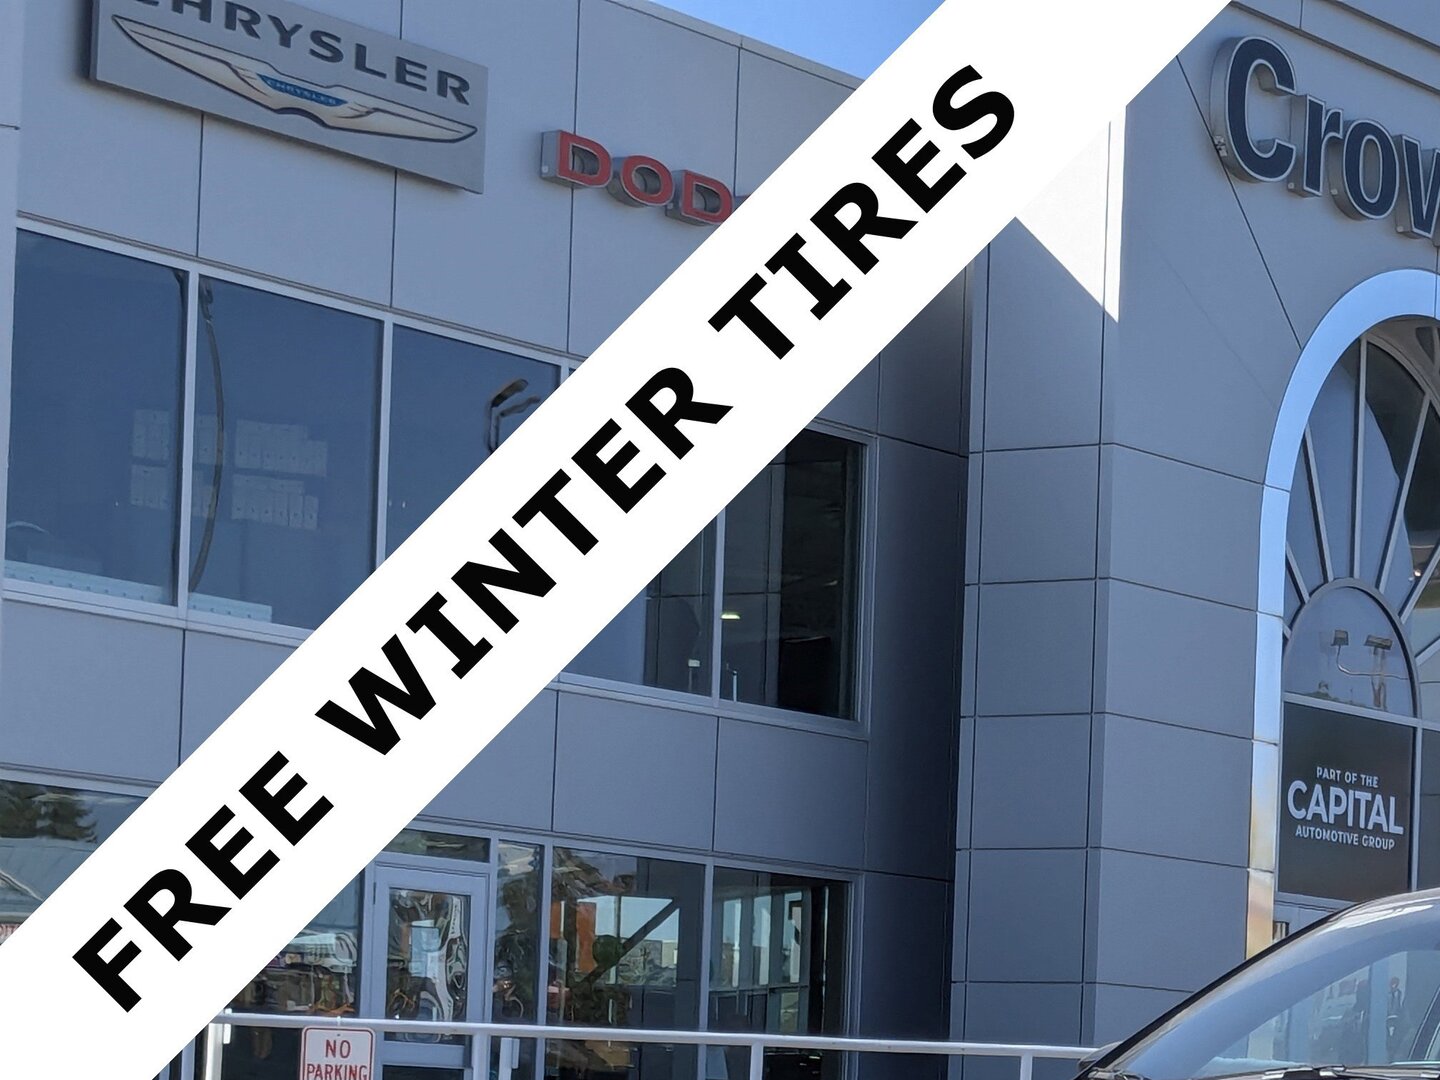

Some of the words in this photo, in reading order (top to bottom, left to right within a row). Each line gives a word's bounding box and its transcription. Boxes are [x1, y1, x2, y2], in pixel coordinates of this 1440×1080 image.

[135, 0, 471, 106] HRYSLER
[548, 130, 737, 225] DOD
[1316, 766, 1341, 782] PART
[1344, 771, 1358, 785] OF
[1360, 774, 1379, 788] THE
[1287, 780, 1404, 834] CAPITAL
[1295, 824, 1359, 845] AUTOMOTIVE
[1362, 835, 1395, 850] GROUP
[325, 1039, 352, 1059] NO
